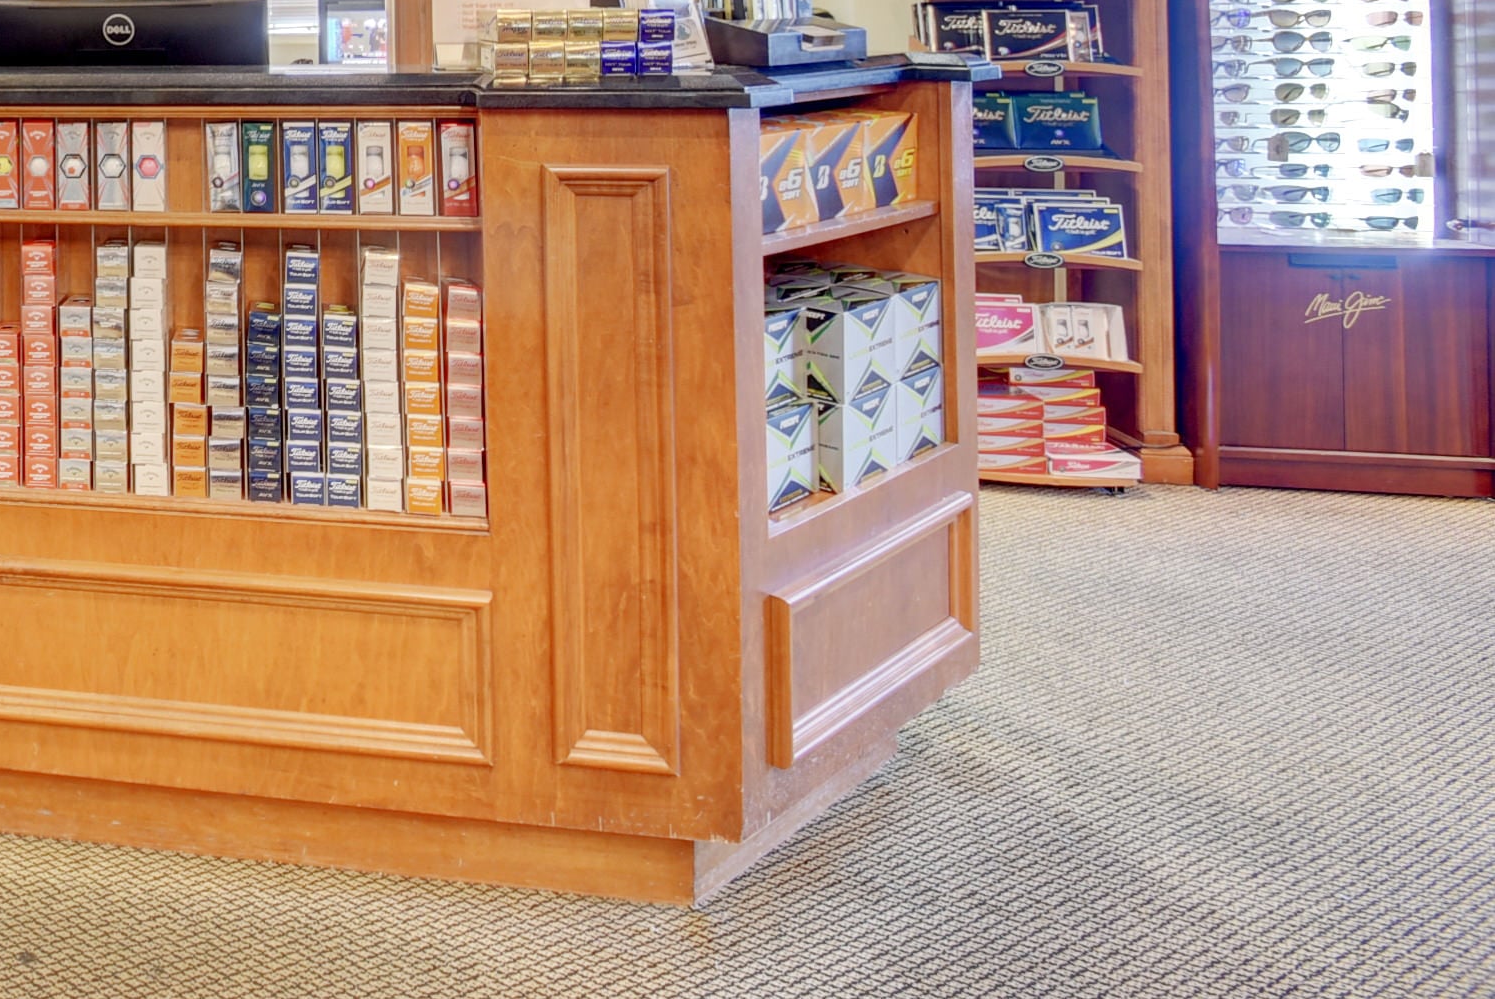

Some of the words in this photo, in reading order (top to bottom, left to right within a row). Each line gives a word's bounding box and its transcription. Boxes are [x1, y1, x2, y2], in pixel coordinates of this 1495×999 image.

[106, 24, 132, 35] DELL
[941, 16, 982, 31] Titl
[995, 19, 1057, 36] Titleist
[1023, 105, 1089, 123] Titleist
[1048, 214, 1110, 231] Titleist
[1306, 293, 1343, 316] Maui
[976, 313, 1023, 329] itleist
[869, 338, 893, 352] EXTREME
[869, 427, 893, 442] EXTREME
